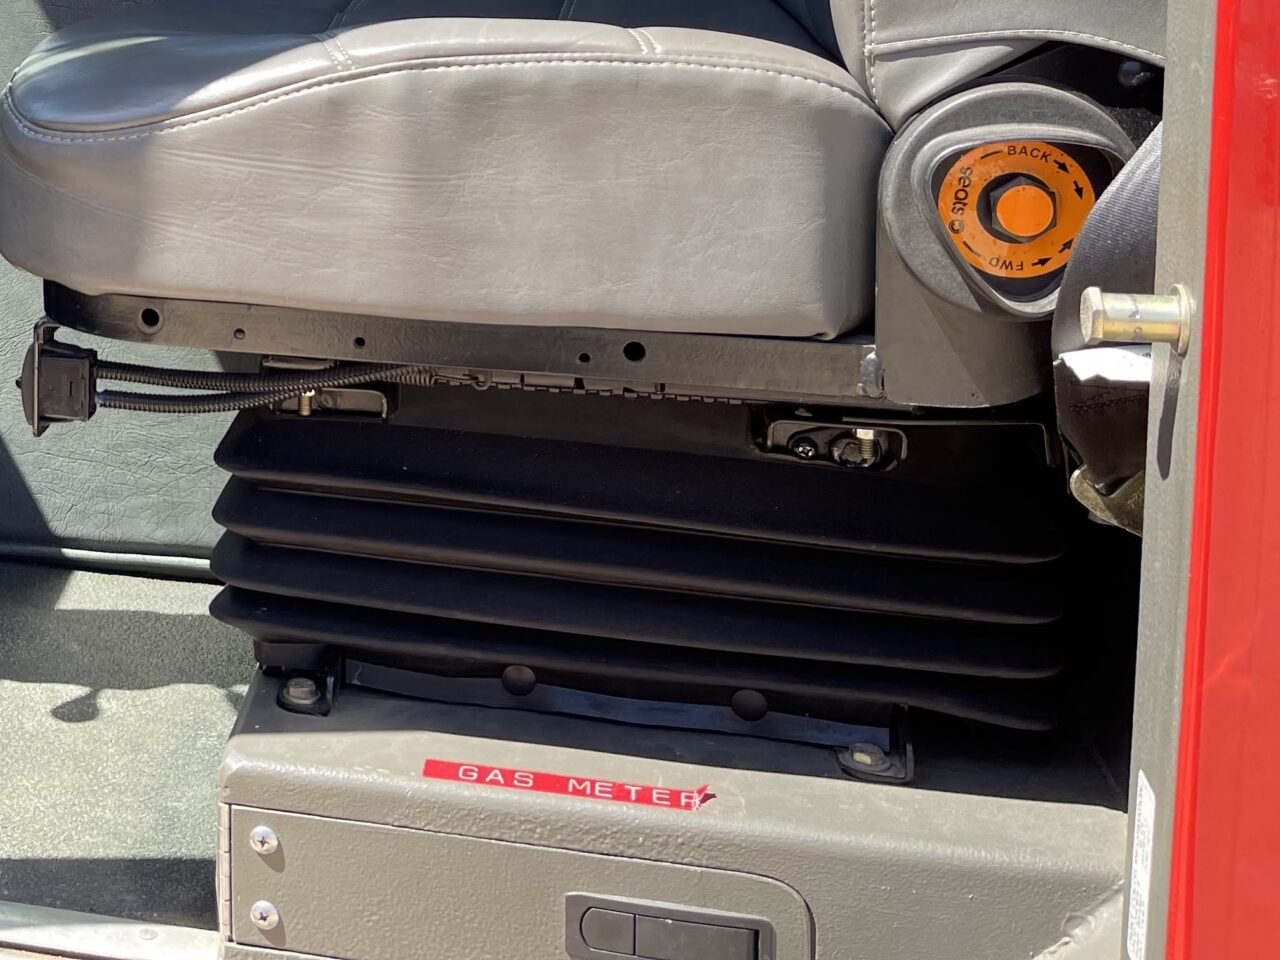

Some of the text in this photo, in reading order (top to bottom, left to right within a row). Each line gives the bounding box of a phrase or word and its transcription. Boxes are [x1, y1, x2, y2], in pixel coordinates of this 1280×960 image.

[1007, 145, 1052, 163] BACK
[951, 166, 973, 216] seats
[989, 257, 1024, 271] FWD
[458, 765, 701, 807] GAS METER
